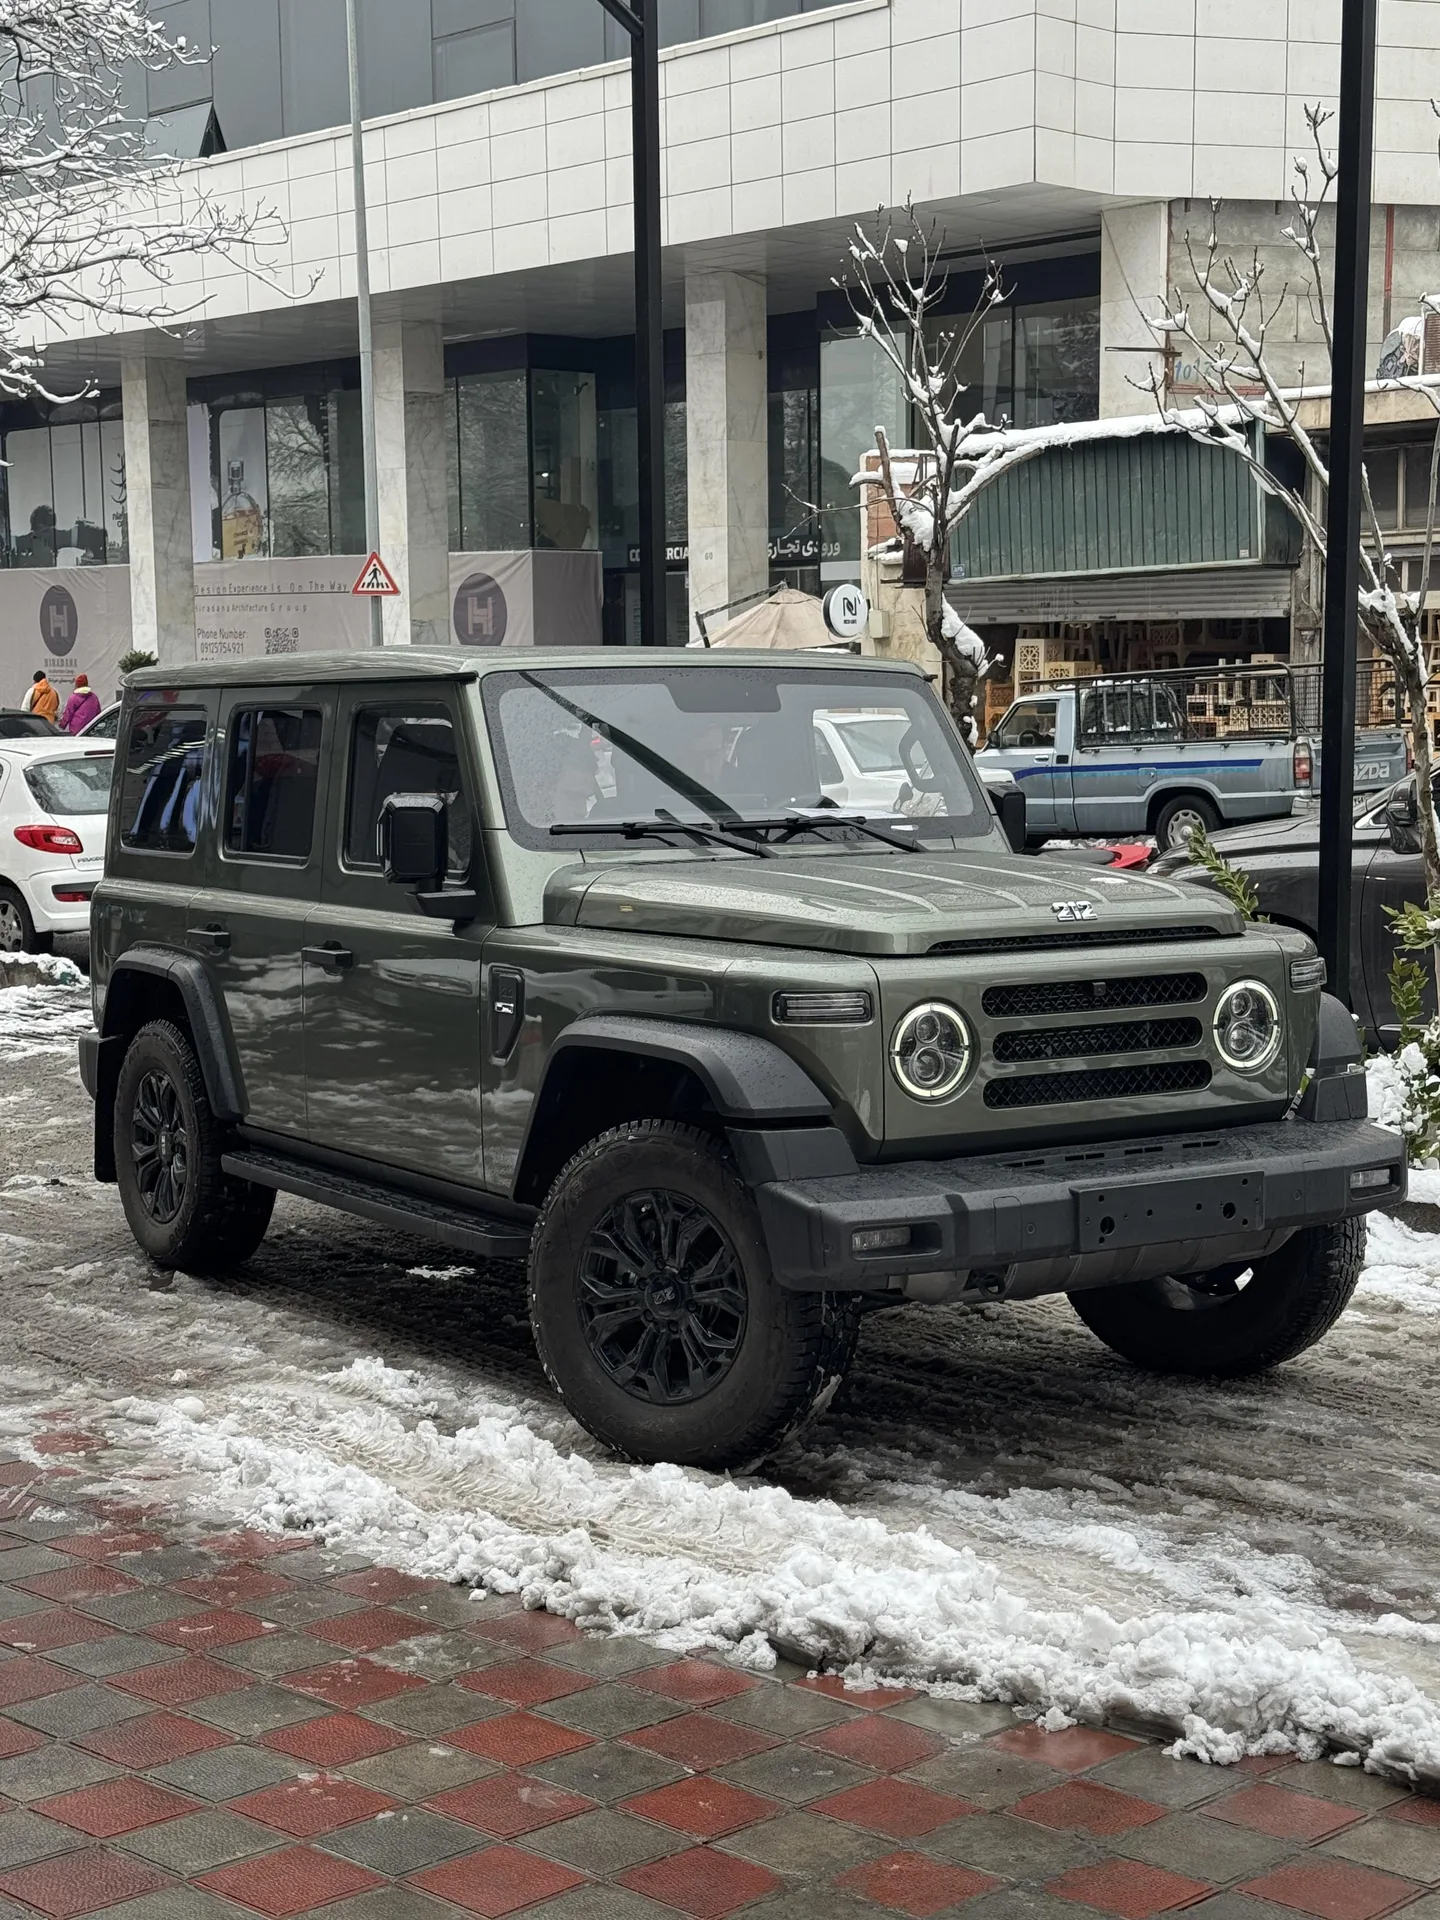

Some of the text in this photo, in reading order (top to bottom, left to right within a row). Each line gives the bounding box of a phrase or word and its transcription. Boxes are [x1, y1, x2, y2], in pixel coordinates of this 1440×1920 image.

[229, 583, 268, 594] Experience
[271, 583, 282, 592] Is
[290, 582, 303, 592] On
[309, 581, 325, 591] The
[329, 580, 348, 591] Way
[270, 603, 308, 613] Group
[197, 628, 218, 639] Phone
[1051, 901, 1098, 922] 212
